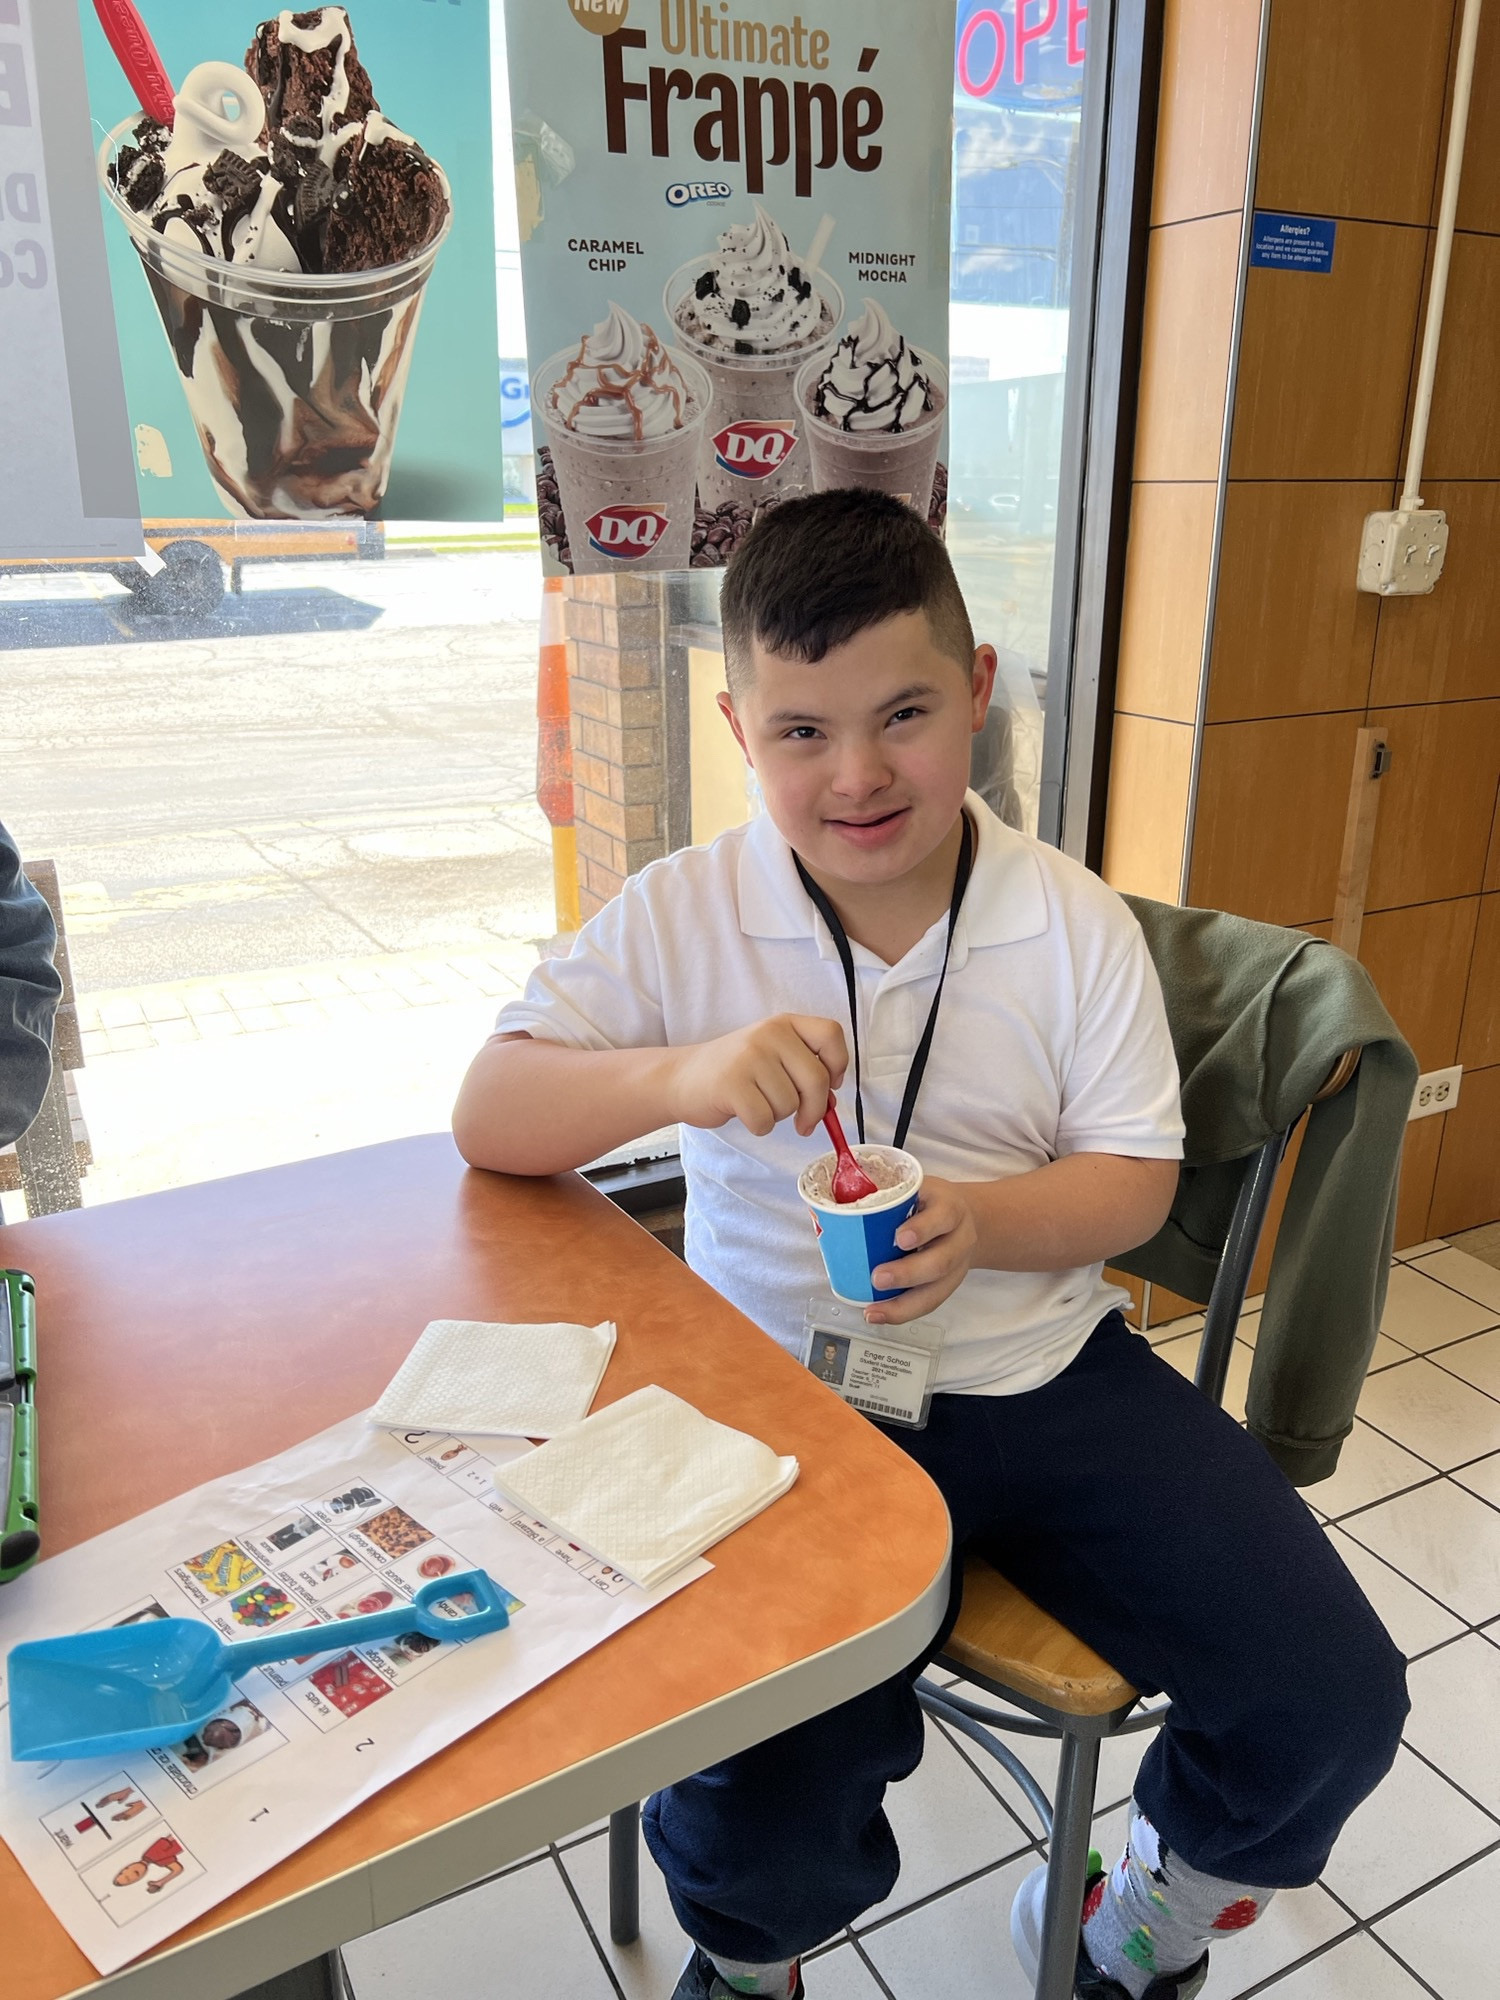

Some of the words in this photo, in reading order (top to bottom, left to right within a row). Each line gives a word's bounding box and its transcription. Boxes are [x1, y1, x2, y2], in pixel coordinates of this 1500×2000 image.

[660, 0, 830, 71] Ultimate
[602, 27, 884, 198] Frappé
[666, 182, 731, 206] OREO
[1280, 224, 1311, 236] Allergies?
[568, 238, 644, 255] CARAMEL
[1263, 235, 1284, 244] Allergens
[588, 258, 627, 272] CHIP
[848, 251, 916, 267] MIDNIGHT
[858, 269, 907, 283] MOCHA
[725, 432, 783, 465] DQ
[598, 515, 657, 547] DQ
[860, 1357, 879, 1366] Student
[880, 1362, 912, 1375] Identification
[864, 1350, 885, 1361] Enger
[886, 1355, 911, 1367] School
[871, 1366, 898, 1377] 2021-2022
[489, 1502, 504, 1513] with
[314, 1510, 332, 1524] oreos
[514, 1520, 540, 1540] blizzard
[260, 1541, 276, 1553] sauce
[348, 1532, 369, 1550] dough
[367, 1544, 388, 1565] cookie
[555, 1549, 574, 1564] have
[278, 1571, 299, 1588] butter
[298, 1571, 319, 1588] sauce
[384, 1568, 405, 1585] sauce
[595, 1579, 610, 1591] Can
[174, 1567, 209, 1604] butterfingers
[294, 1586, 317, 1605] peanut
[315, 1606, 334, 1621] sauce
[436, 1599, 459, 1619] candy
[365, 1648, 387, 1670] fudge
[262, 1664, 290, 1687] peanut
[383, 1665, 399, 1679] hot
[304, 1691, 322, 1708] kats
[317, 1703, 332, 1717] kit
[355, 1737, 376, 1752] 2
[166, 1763, 198, 1795] chocolate
[249, 1807, 271, 1823] 1
[53, 1827, 75, 1850] want
